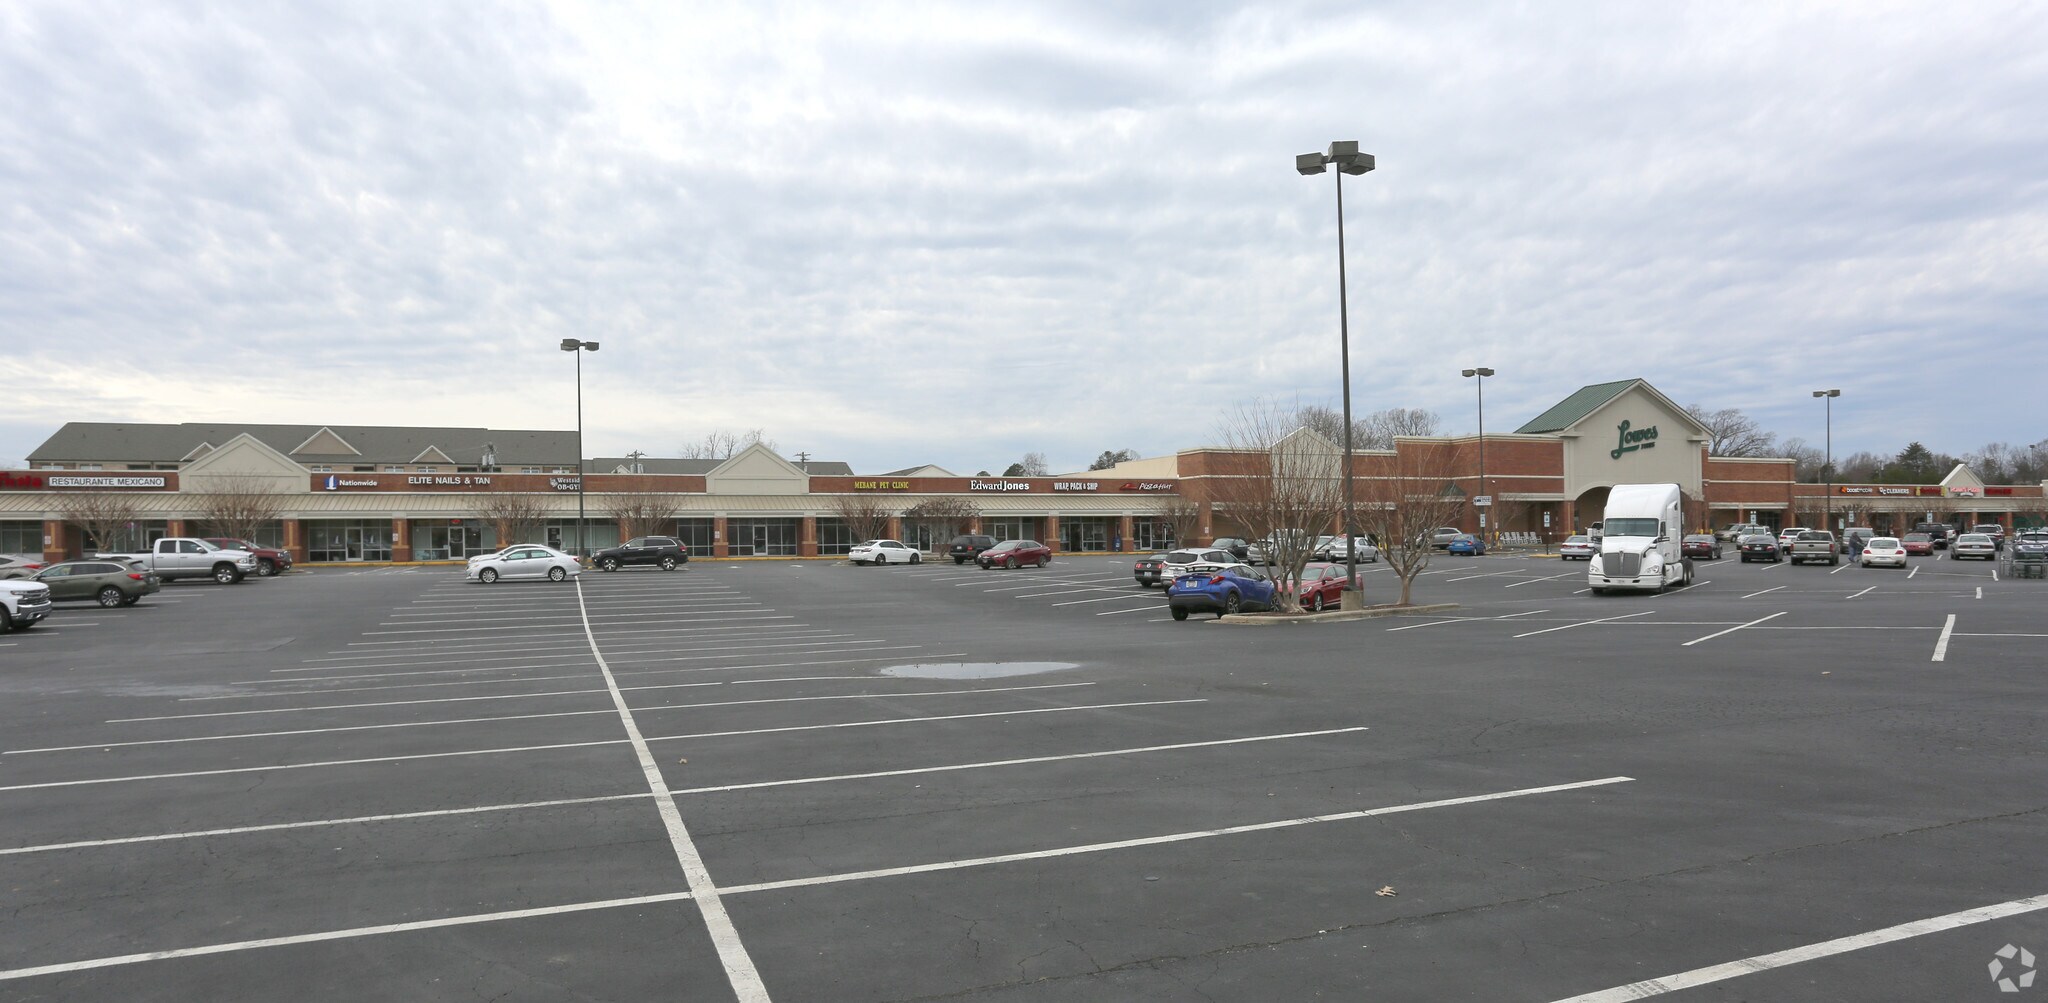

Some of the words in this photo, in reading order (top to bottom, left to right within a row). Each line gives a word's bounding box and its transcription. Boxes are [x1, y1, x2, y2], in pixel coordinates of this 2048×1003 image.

[1611, 419, 1658, 460] Lowes
[51, 478, 115, 486] RESTAURANTE
[117, 478, 163, 486] MEXICANO
[339, 479, 378, 487] Nationwide
[408, 476, 432, 485] ELITE
[435, 476, 461, 485] NAILS
[464, 477, 471, 485] &
[474, 477, 491, 485] TAN
[854, 481, 877, 489] MEBANE
[879, 481, 890, 489] PET
[892, 481, 909, 489] CLINIC
[970, 480, 1003, 490] Edward
[1003, 480, 1030, 491] Jones
[1070, 482, 1083, 490] PACK
[1087, 482, 1098, 490] SHIP
[1139, 482, 1158, 490] Pizza
